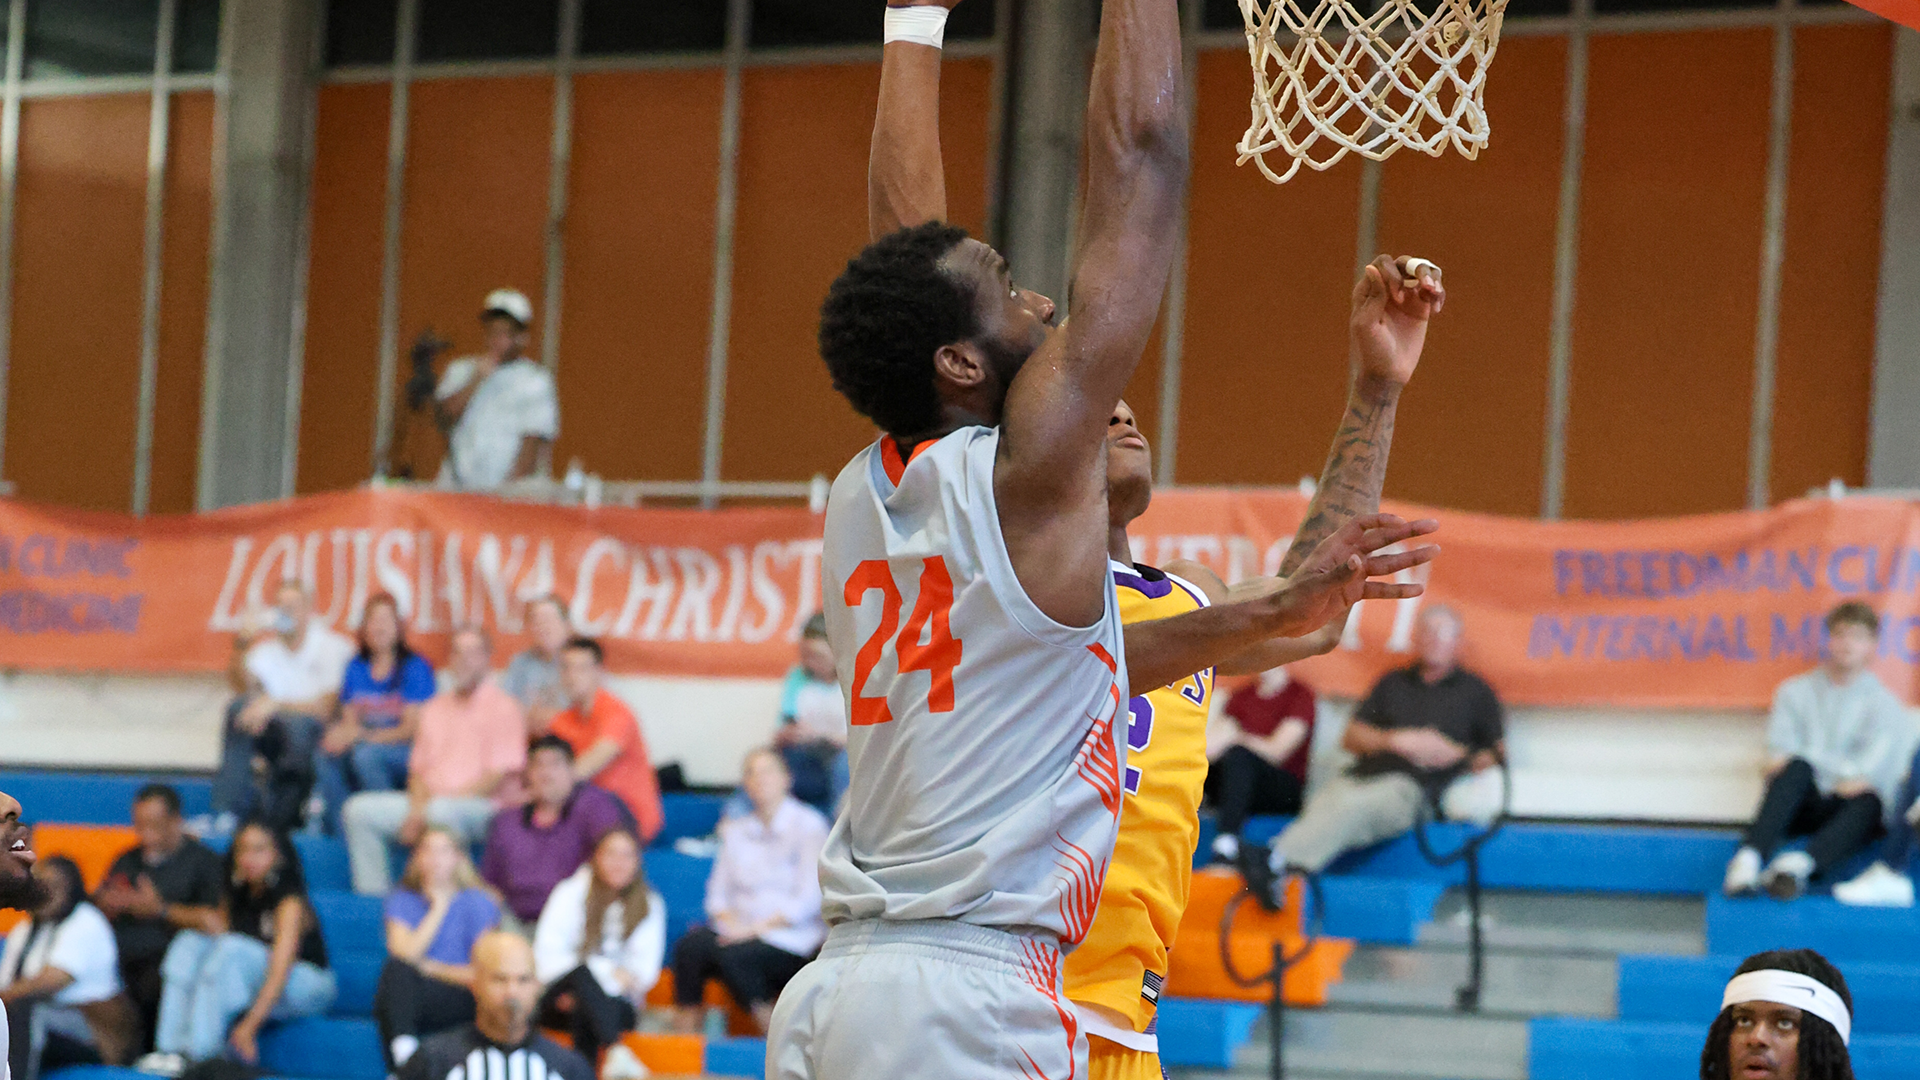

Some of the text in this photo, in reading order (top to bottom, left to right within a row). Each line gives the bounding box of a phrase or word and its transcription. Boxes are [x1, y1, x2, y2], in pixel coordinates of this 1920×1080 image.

[208, 528, 825, 643] LOUISIANA CHRIST
[1554, 545, 1819, 599] FREEDMAN
[843, 554, 963, 726] 24
[1527, 613, 1757, 662] INTERNAL
